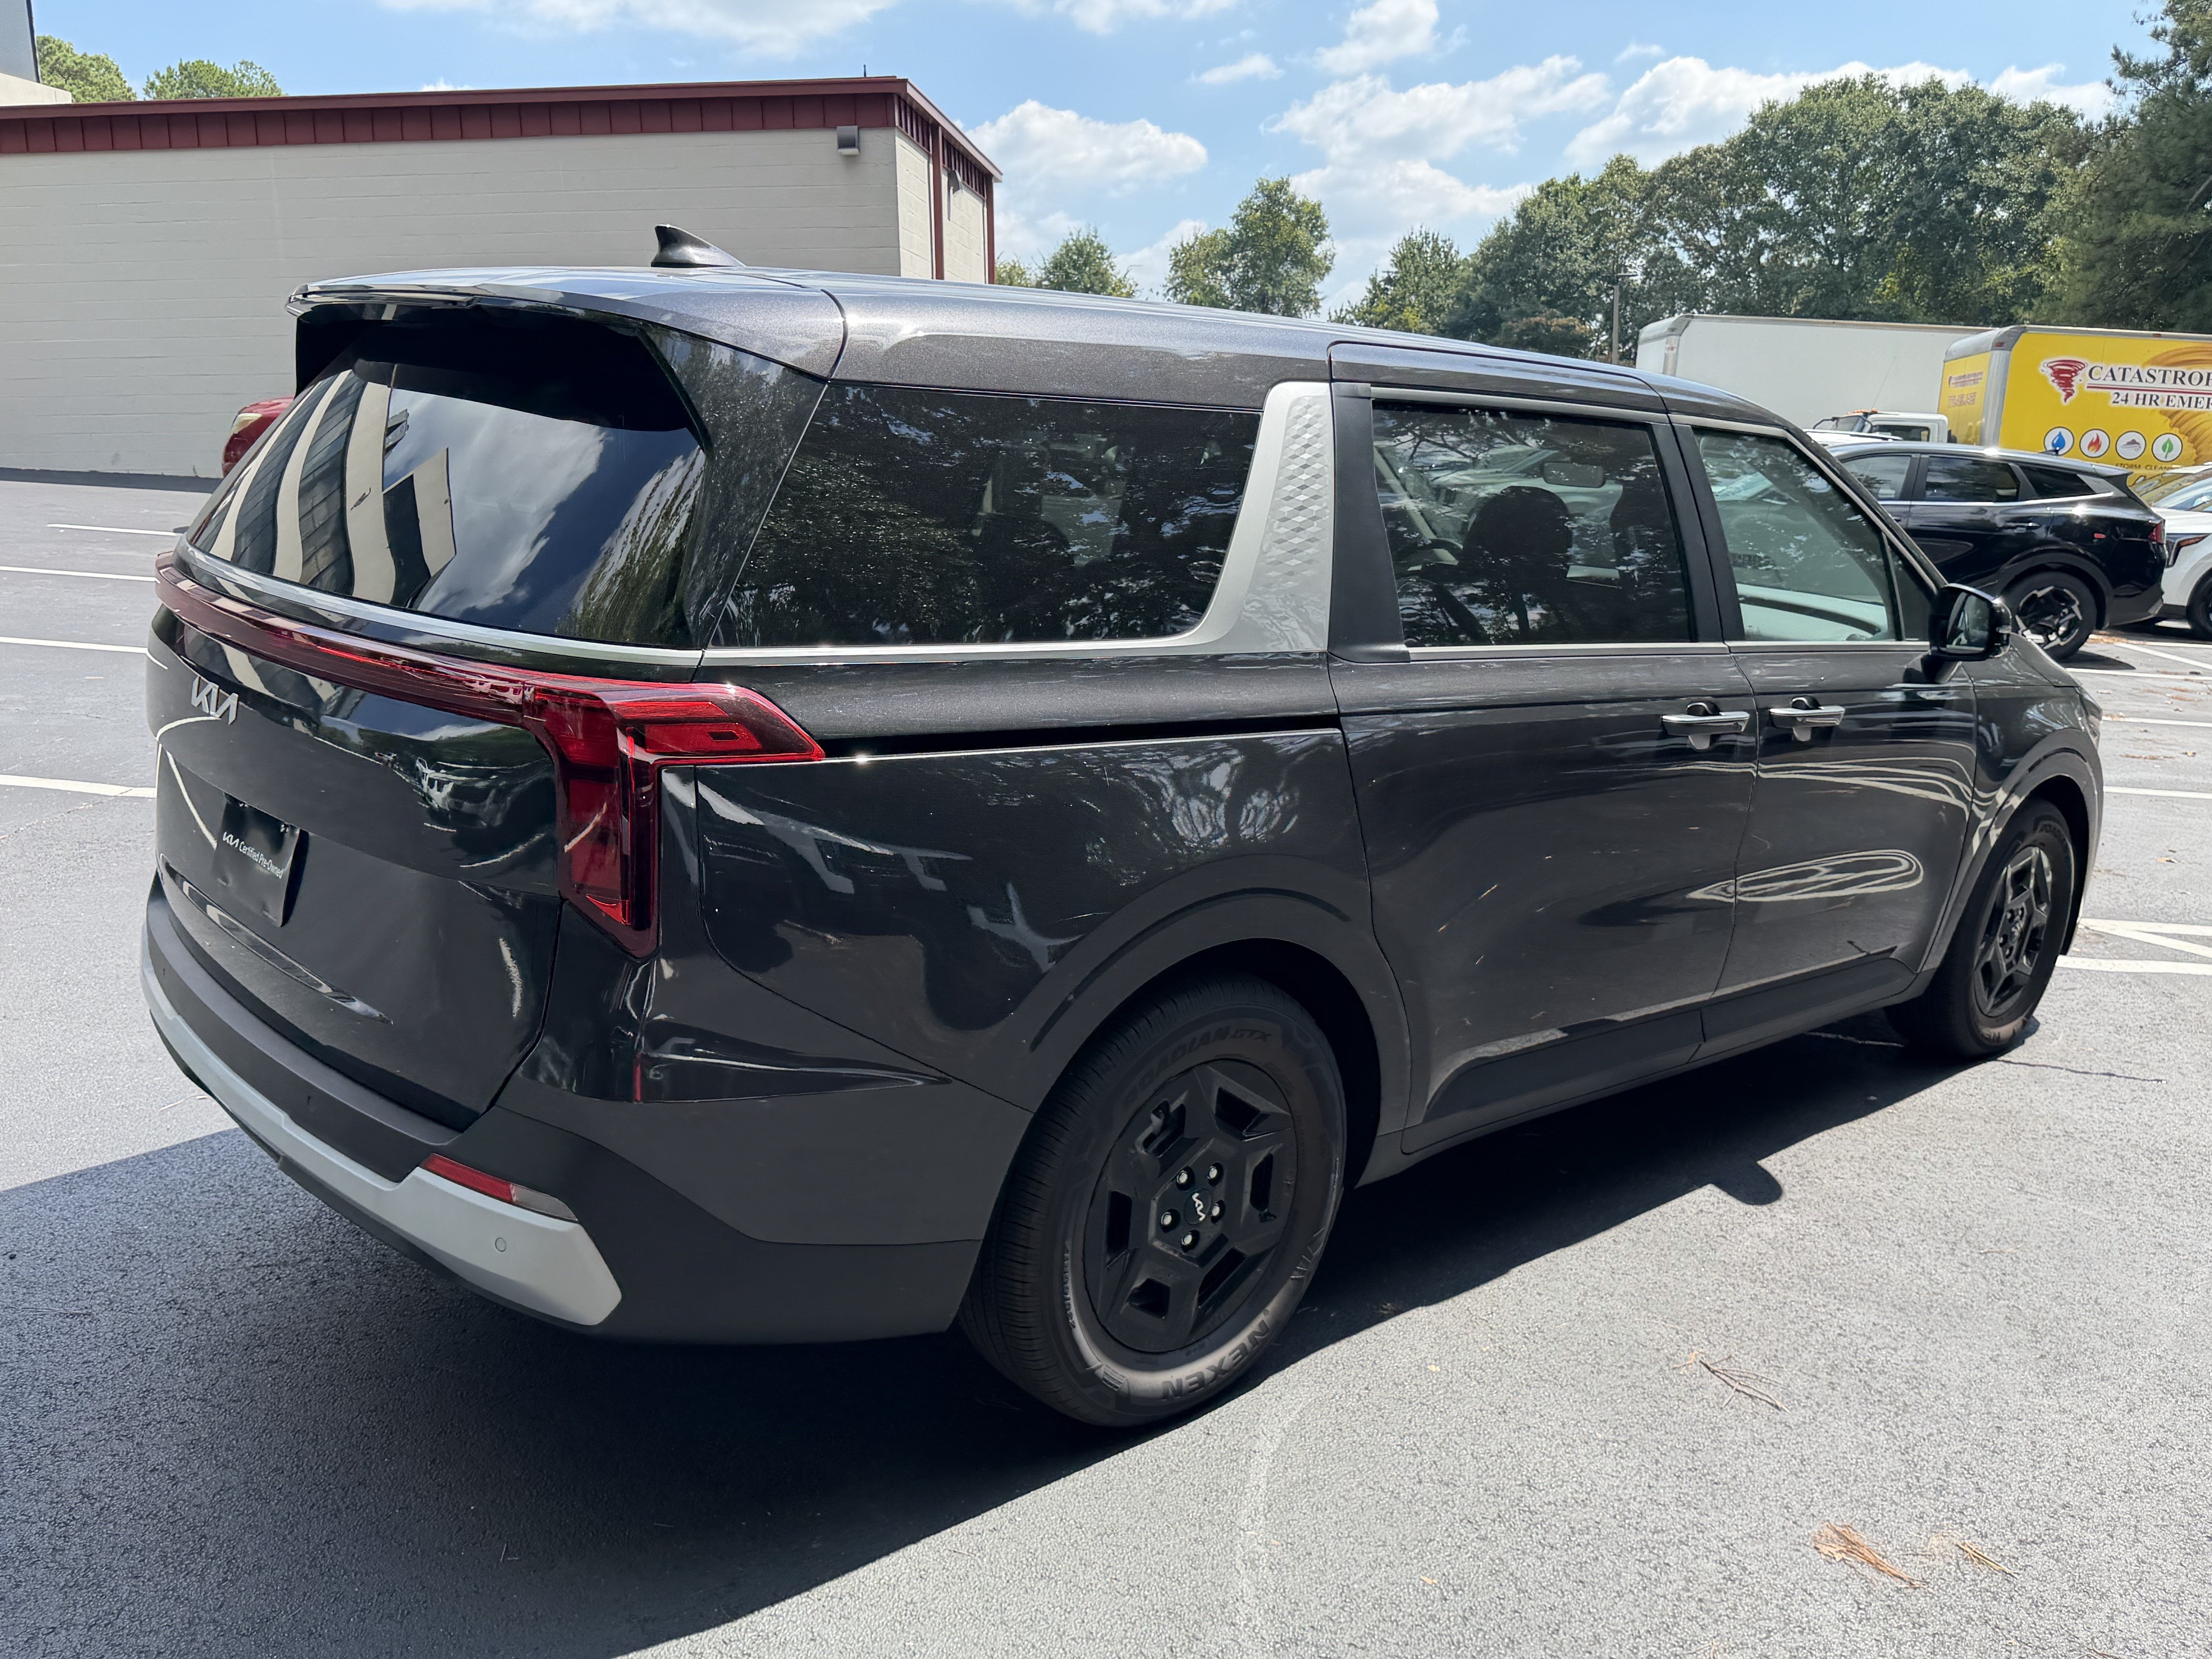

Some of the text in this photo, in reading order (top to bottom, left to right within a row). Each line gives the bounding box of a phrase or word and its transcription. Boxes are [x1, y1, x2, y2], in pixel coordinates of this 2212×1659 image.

[2112, 392, 2129, 404] 24
[2135, 393, 2160, 406] HR
[191, 675, 239, 725] KIA
[223, 832, 239, 848] KIA
[1231, 1028, 1272, 1042] GTX
[1161, 1319, 1270, 1400] NEXEN
